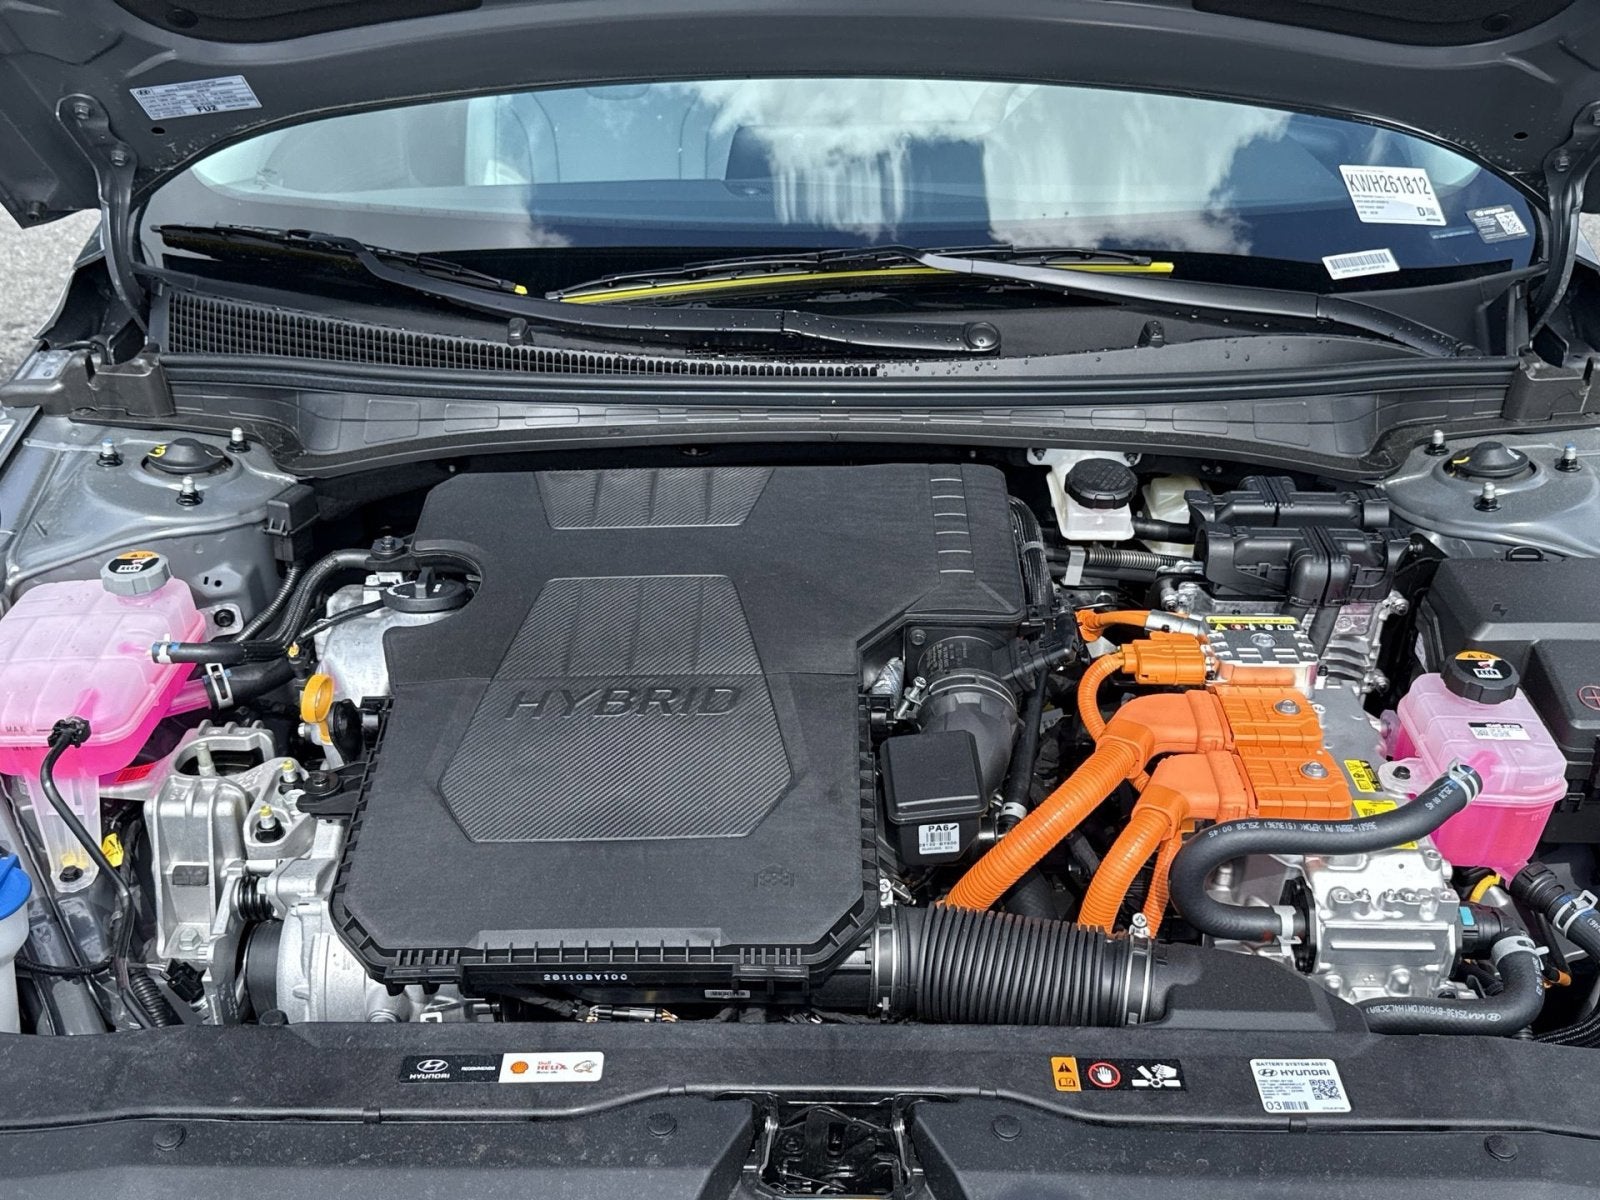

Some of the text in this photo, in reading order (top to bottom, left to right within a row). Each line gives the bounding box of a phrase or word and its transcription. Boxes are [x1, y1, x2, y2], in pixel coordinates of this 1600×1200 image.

[1346, 174, 1431, 195] KWH261812
[1417, 206, 1426, 217] D
[505, 688, 738, 720] HYBRID
[1265, 1101, 1282, 1110] 03
